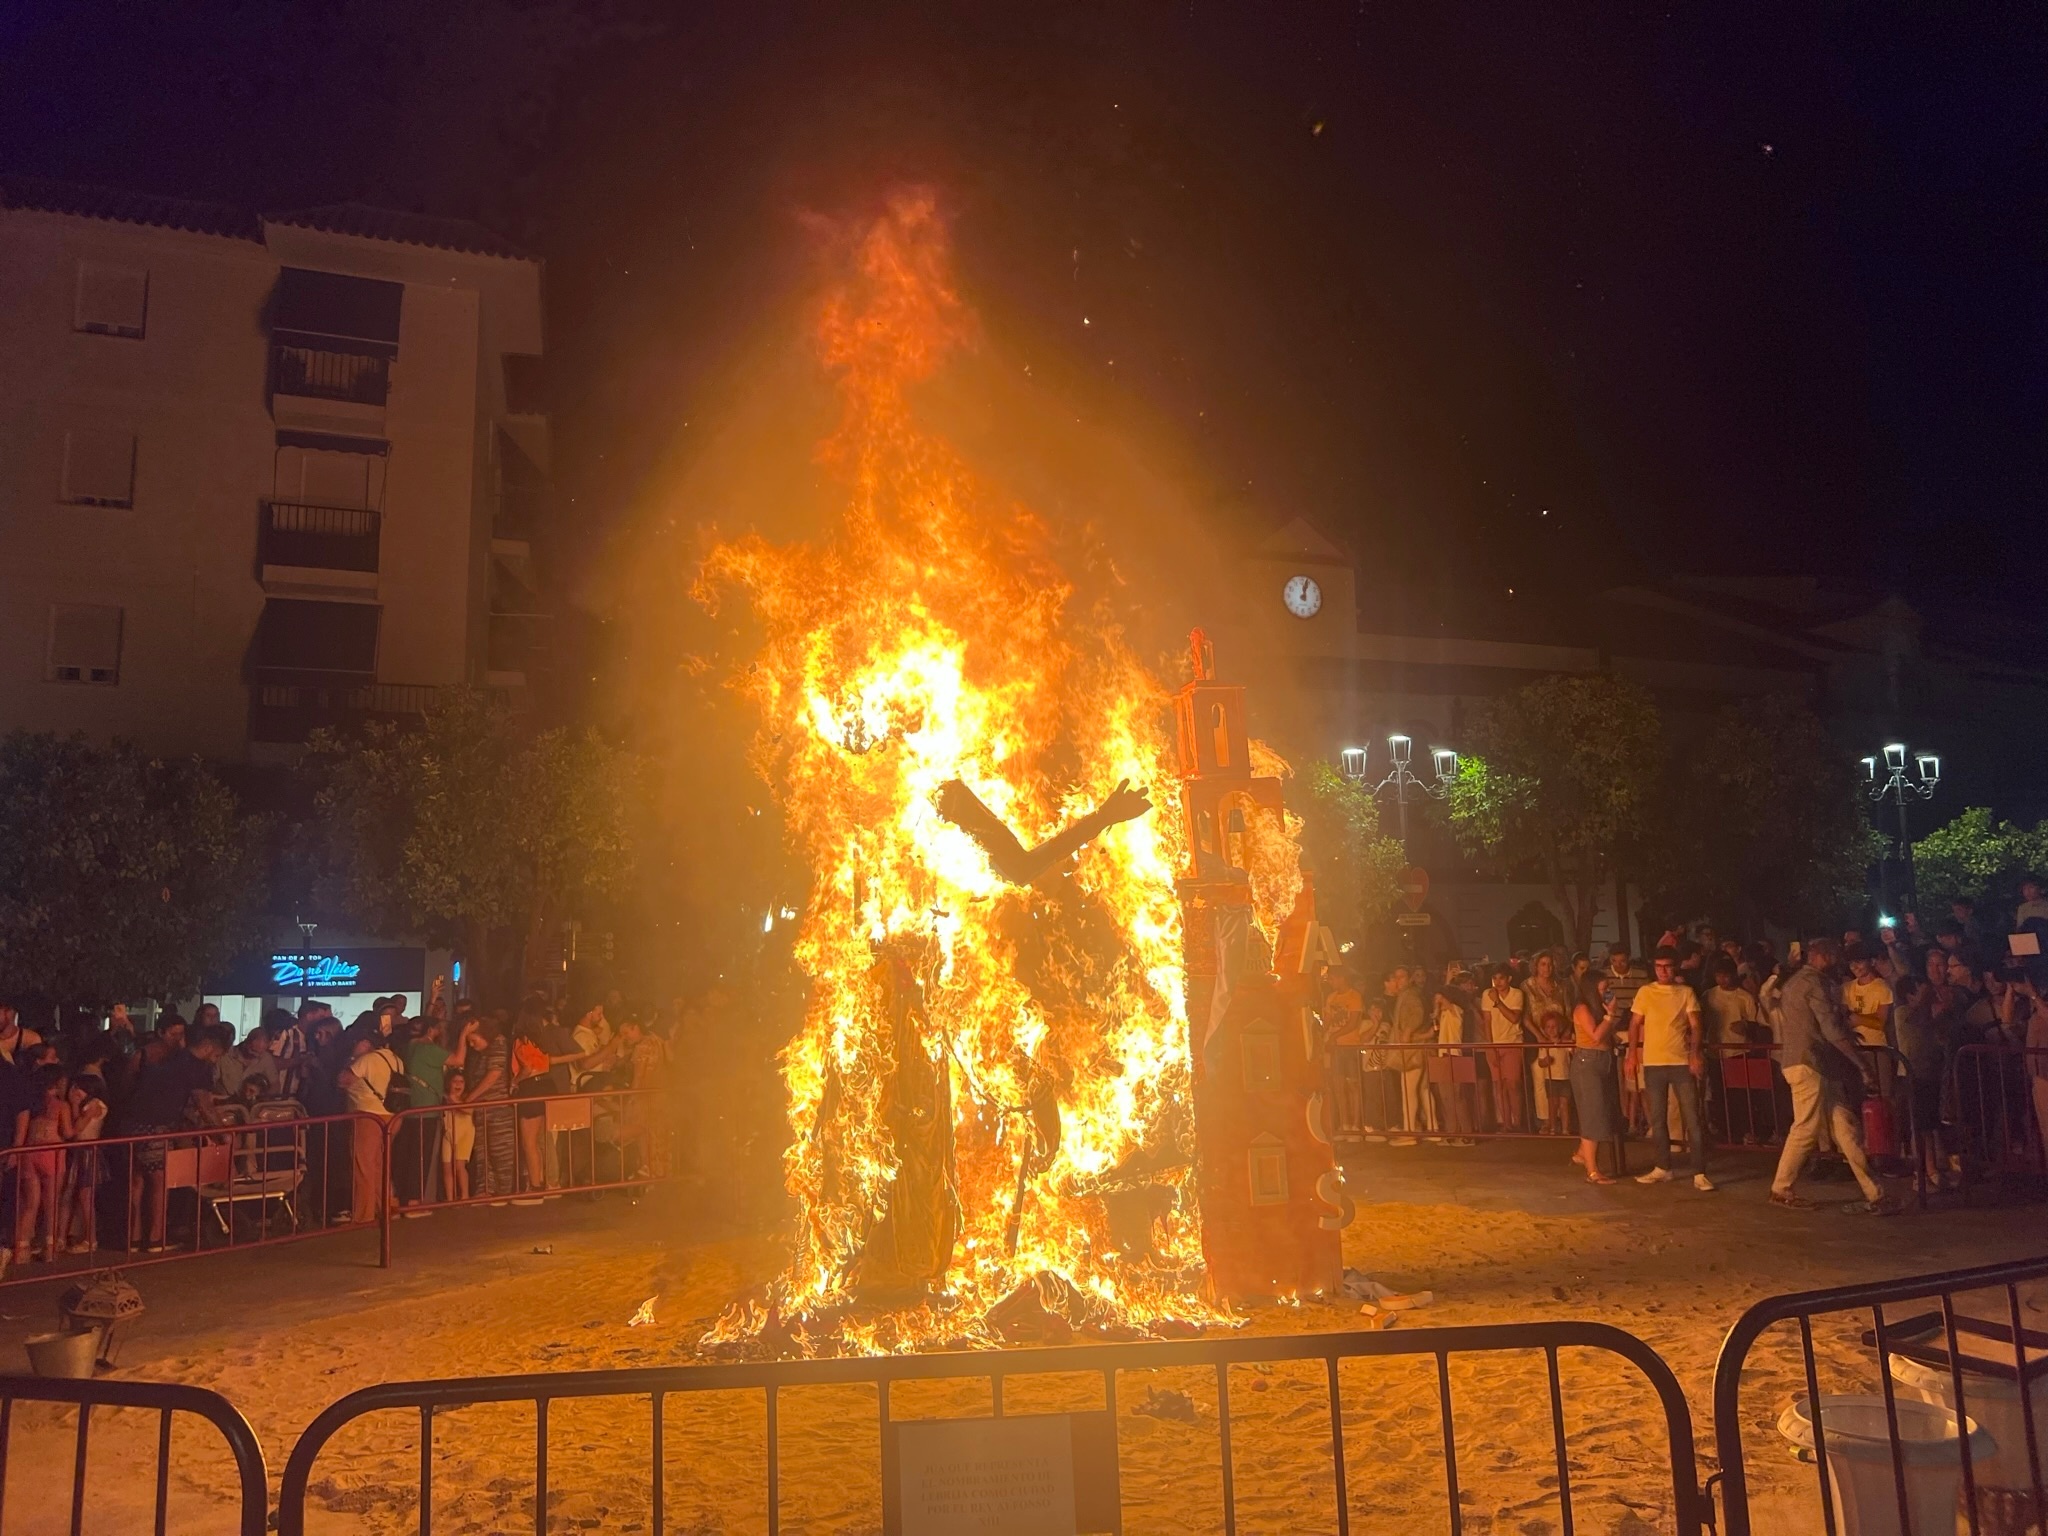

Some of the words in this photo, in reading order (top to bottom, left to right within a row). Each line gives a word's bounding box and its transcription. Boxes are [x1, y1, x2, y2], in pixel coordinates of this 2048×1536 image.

[948, 1462, 970, 1473] QUE
[971, 1487, 1008, 1499] COMO
[1010, 1484, 1055, 1497] CIUDAD
[927, 1503, 950, 1515] POR
[970, 1502, 994, 1513] REY
